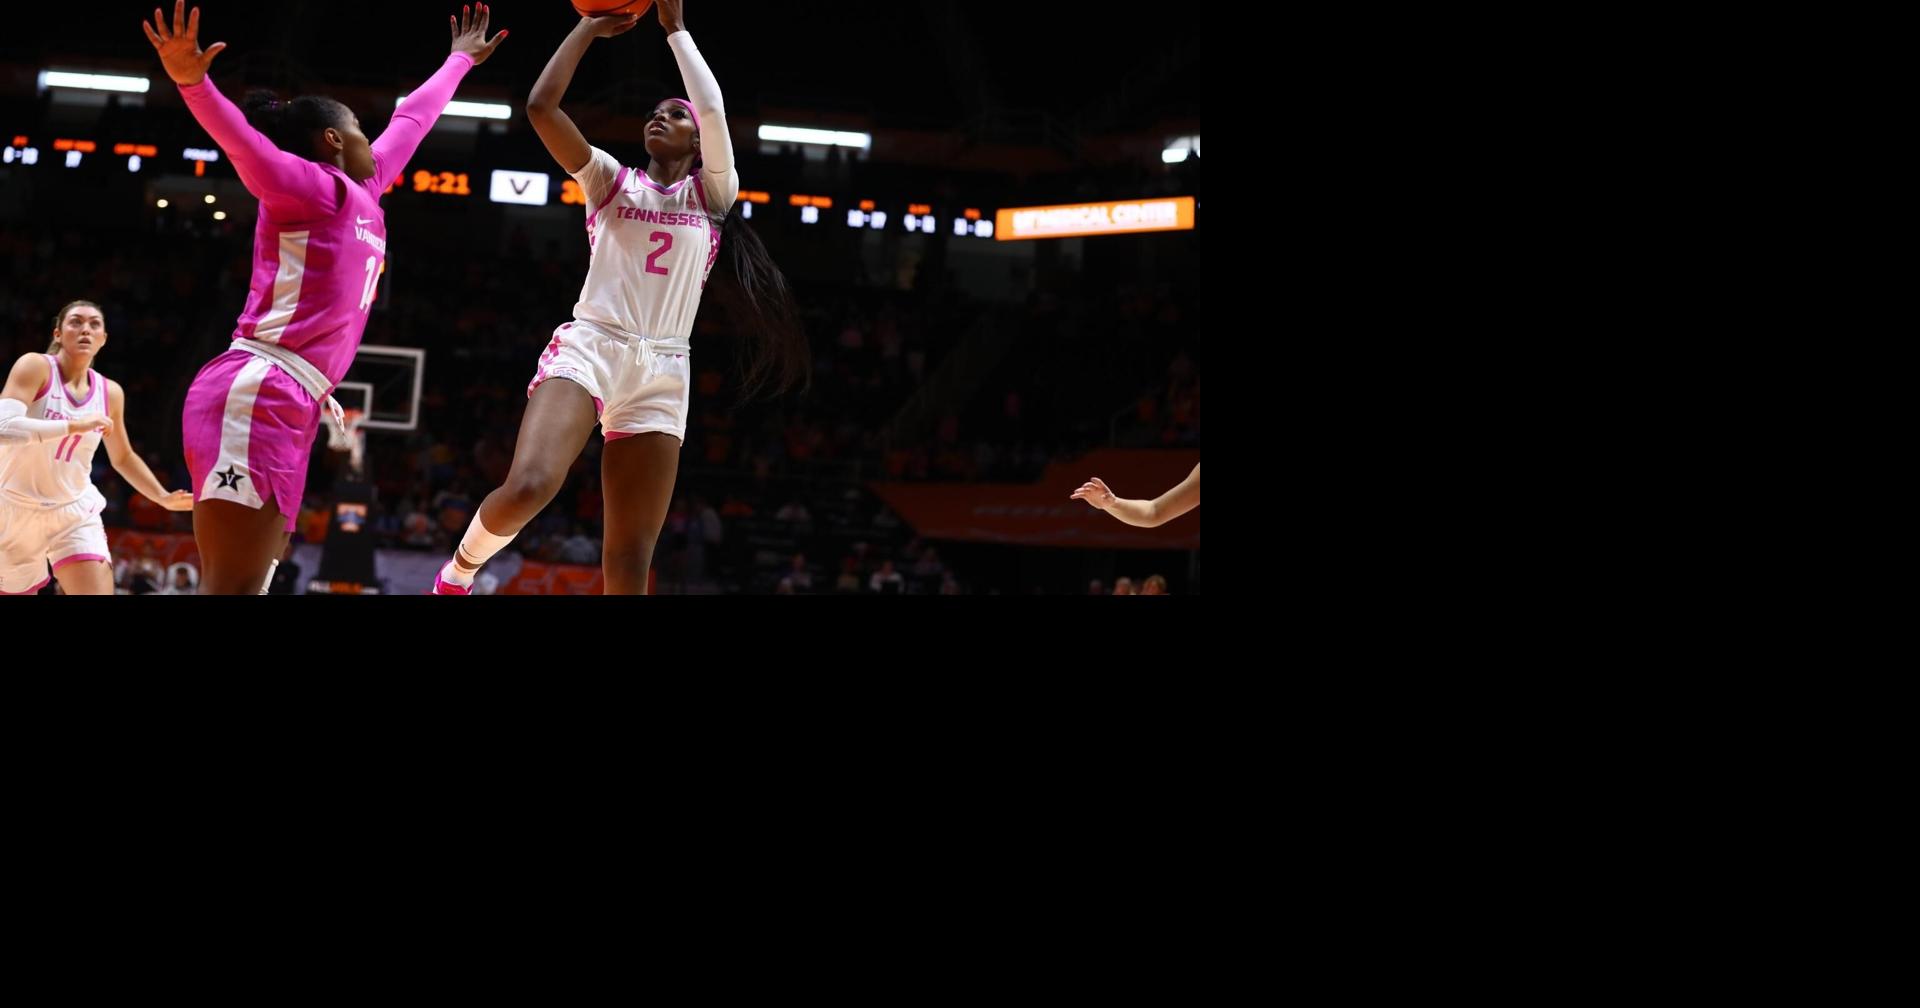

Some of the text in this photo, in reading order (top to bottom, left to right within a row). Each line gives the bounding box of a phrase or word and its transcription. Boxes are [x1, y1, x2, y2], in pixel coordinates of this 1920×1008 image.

[413, 169, 471, 195] 9:21
[616, 206, 703, 229] TENNESSEE
[645, 231, 673, 275] 2
[54, 434, 82, 462] 11
